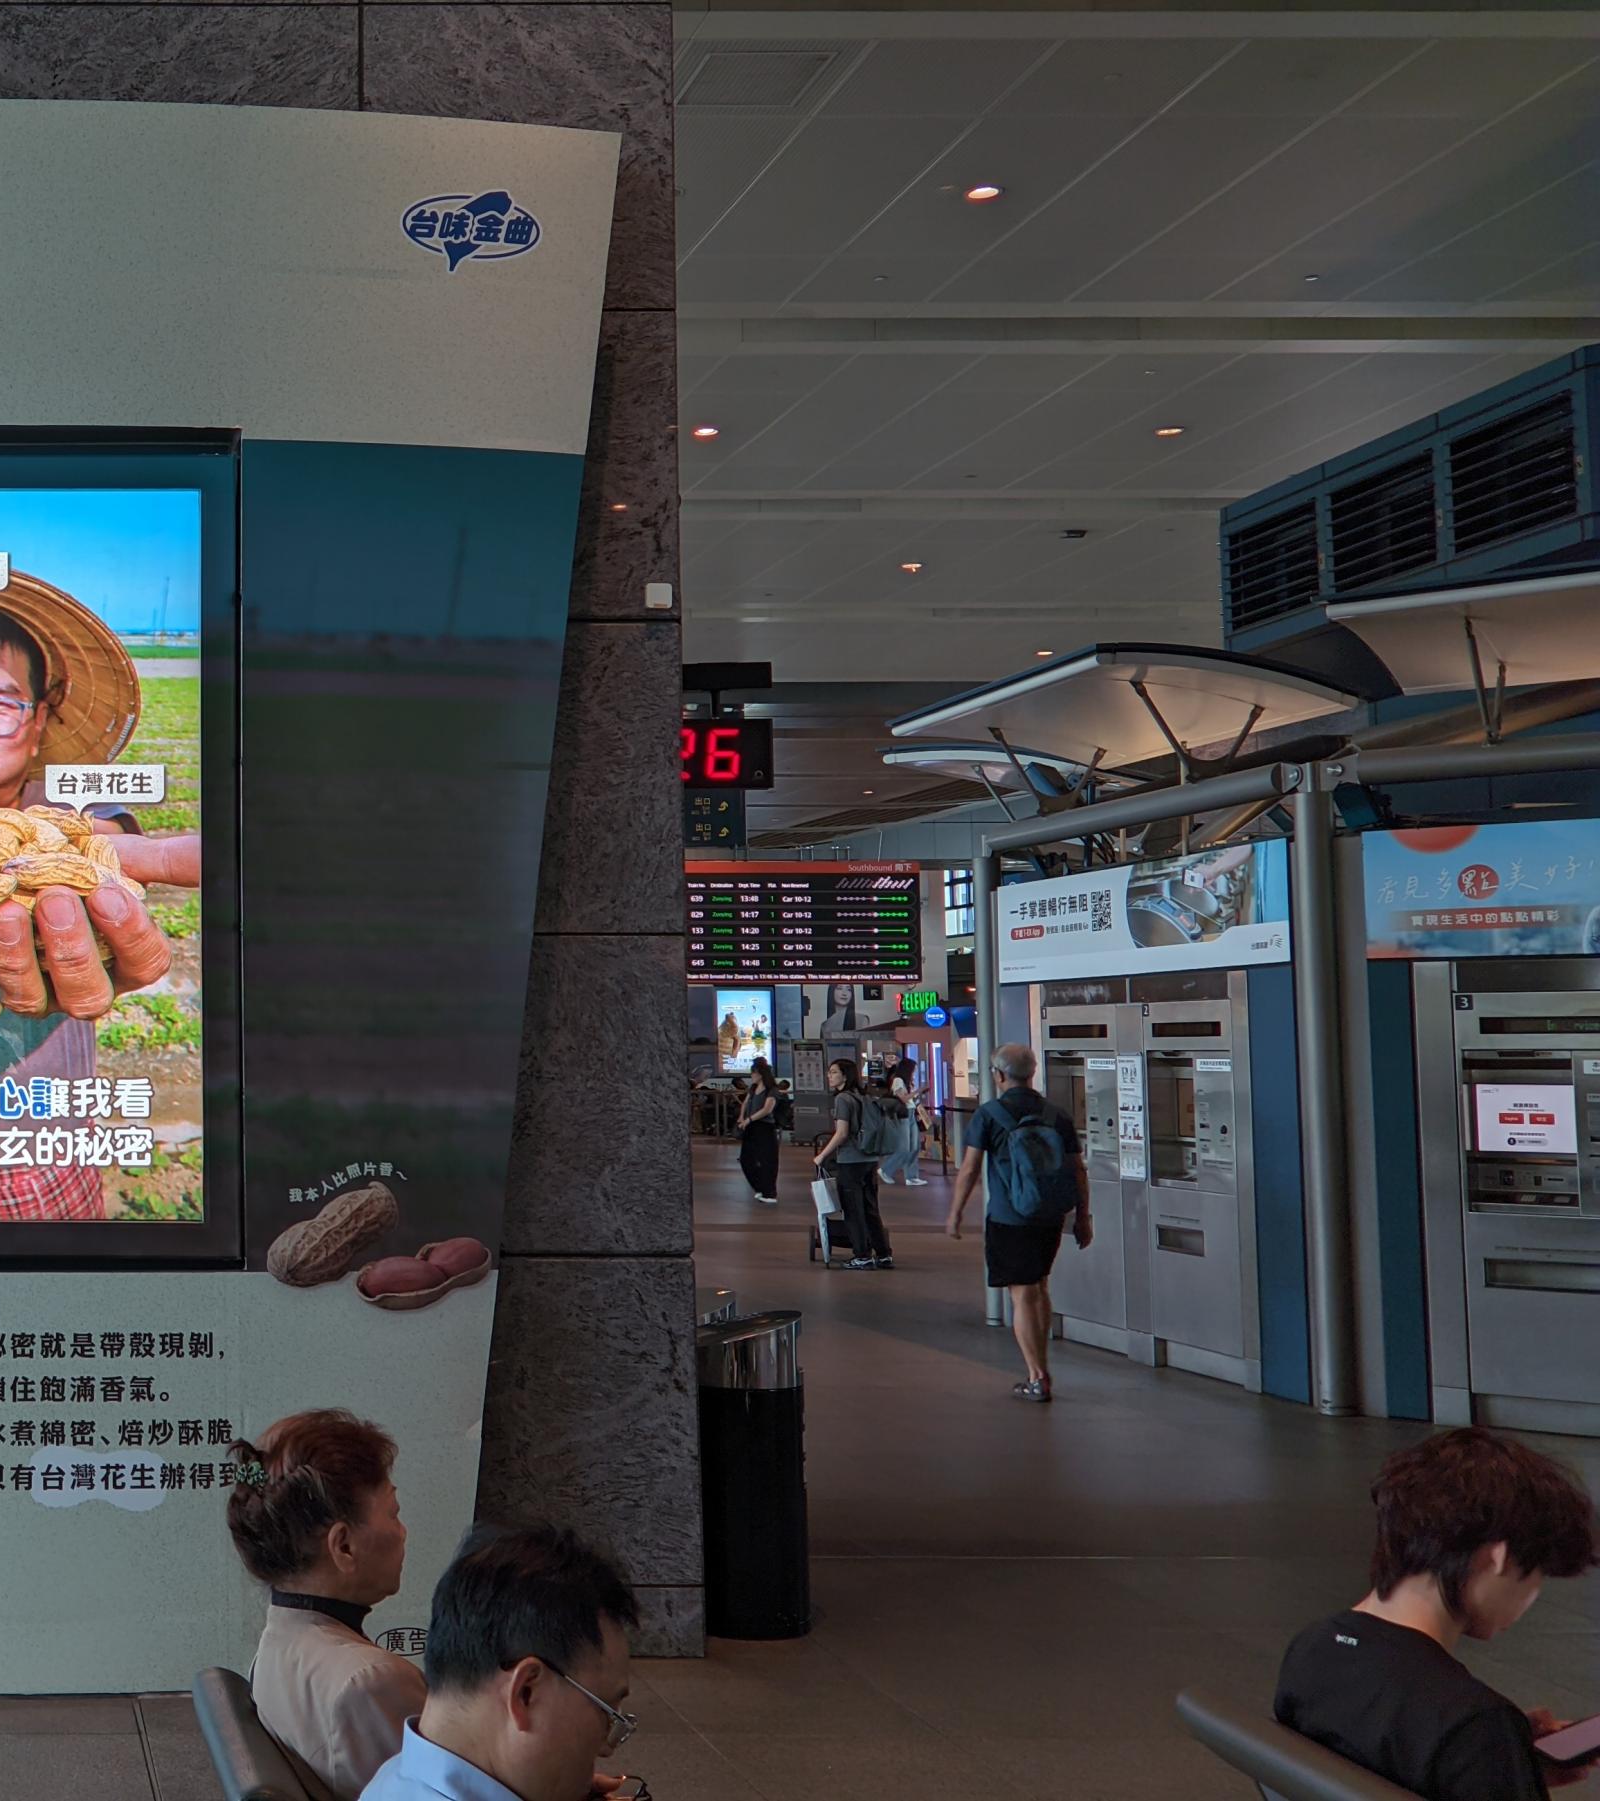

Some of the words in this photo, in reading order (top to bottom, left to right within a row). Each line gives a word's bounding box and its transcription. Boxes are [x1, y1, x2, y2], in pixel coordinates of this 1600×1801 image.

[409, 208, 536, 245] 台味金曲
[56, 772, 154, 795] 台灣花生
[847, 864, 893, 873] Southbound
[782, 895, 793, 903] Car
[794, 895, 811, 903] 10-12
[740, 911, 759, 919] 14:17
[782, 911, 793, 920] Car
[794, 911, 811, 920] 10-12
[783, 927, 794, 935] Car
[795, 927, 812, 935] 10-12
[783, 943, 794, 951] Car
[795, 943, 812, 951] 10-12
[784, 960, 794, 968] Car
[796, 960, 812, 968] 10-12
[1460, 997, 1469, 1009] 3
[386, 1630, 427, 1652] 廣告
